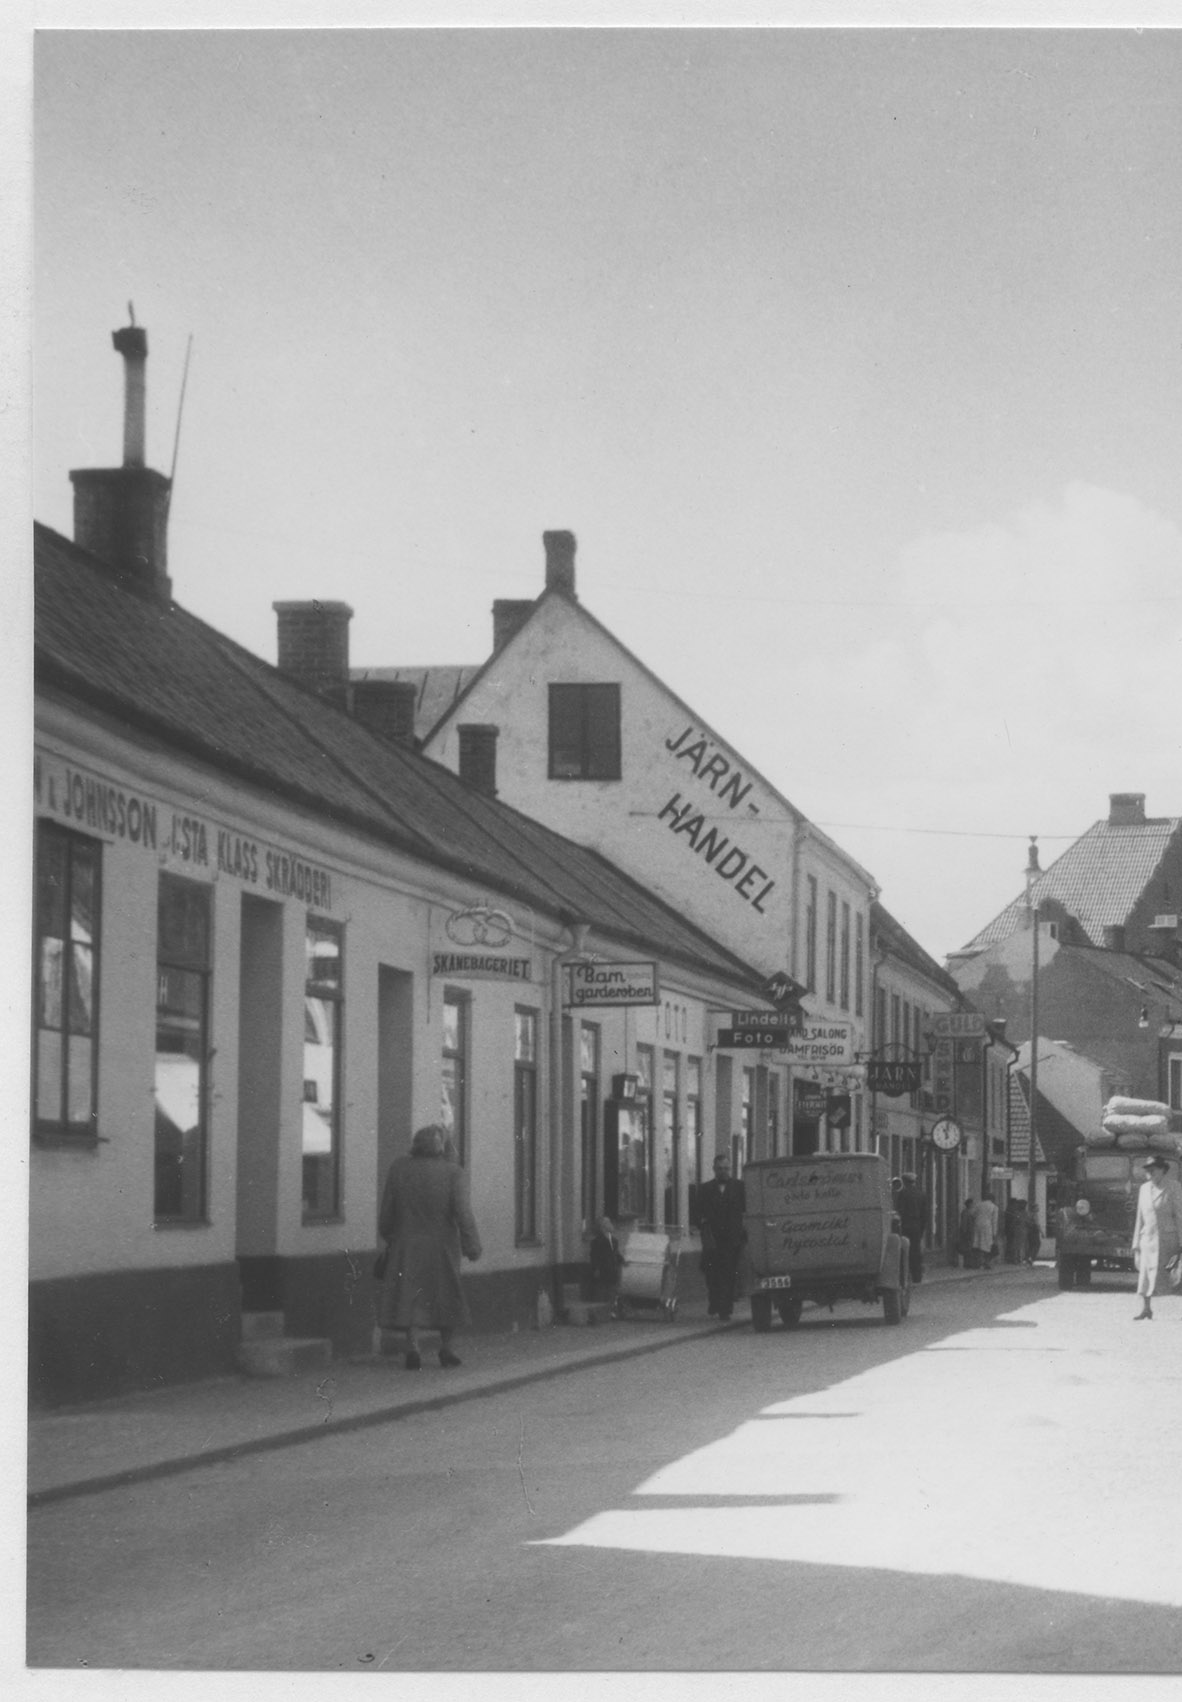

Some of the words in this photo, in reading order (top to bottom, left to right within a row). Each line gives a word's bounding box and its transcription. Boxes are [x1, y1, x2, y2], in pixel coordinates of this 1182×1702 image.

[665, 726, 760, 814] JÄRN-
[63, 768, 157, 850] JOHNSSON
[217, 829, 258, 884] KLASS
[266, 850, 332, 910] SKRÄDDERI
[657, 793, 775, 914] HANDEL
[576, 963, 625, 983] Barn
[575, 983, 654, 1003] garderoben
[737, 1012, 797, 1026] Lindells
[733, 1031, 773, 1044] Foto
[810, 1027, 847, 1039] SALONG
